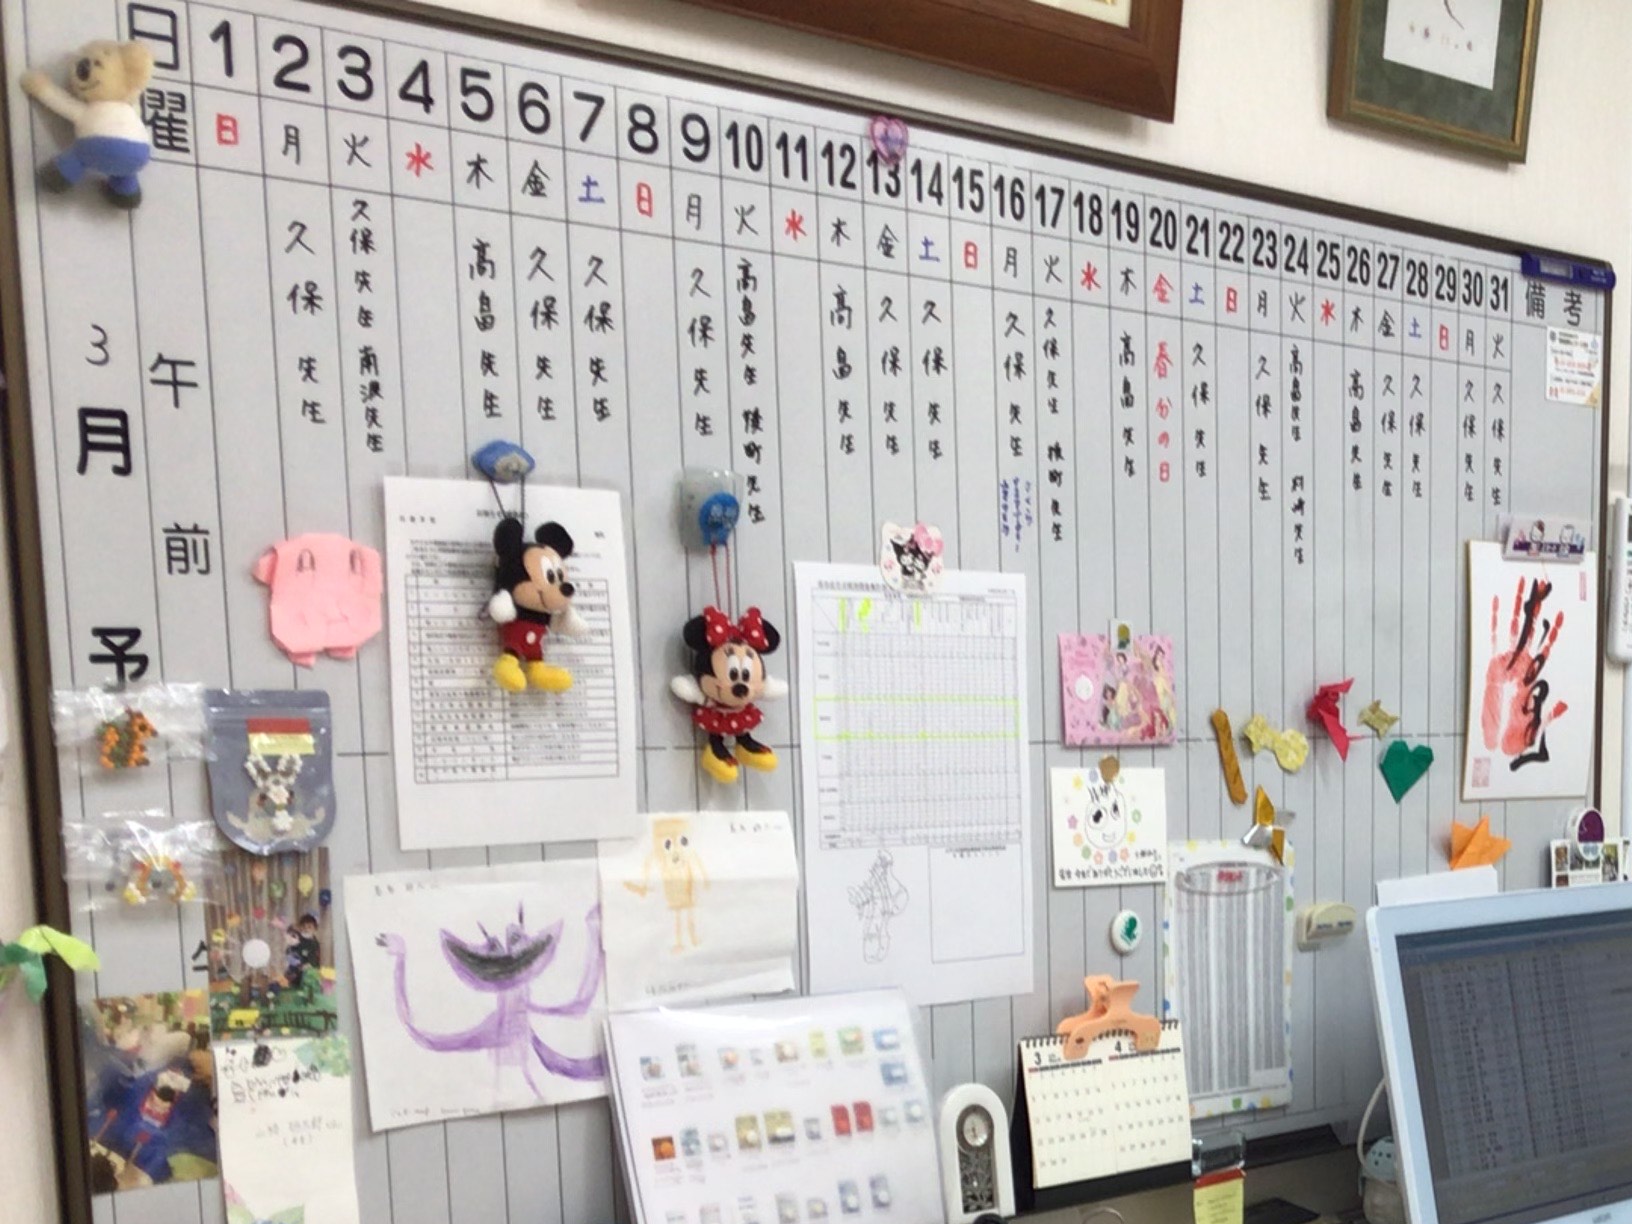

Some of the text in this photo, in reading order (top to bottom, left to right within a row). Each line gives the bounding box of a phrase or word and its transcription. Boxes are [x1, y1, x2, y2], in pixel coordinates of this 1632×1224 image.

[127, 2, 1582, 327] 日 1 2 3 4 5 6 7 8 9 10 11 12 13 14 15 16 17 18 19 20 21 22 23 24 25 26 27 28 29 30 31 備考
[140, 87, 191, 154] 曜
[216, 113, 1505, 359] 日 月 火 水 木 金 土 日 月 火 水 木 金 土 日 月 火 水 木 金 土 日 月 火 水 木 金 土 日 月 火
[350, 199, 377, 328] 久保先生
[86, 323, 110, 367] 3
[149, 352, 198, 409] 午
[284, 220, 326, 424] 久保先生
[527, 246, 560, 421] 久保先生
[583, 255, 615, 422] 久保先生
[687, 267, 715, 437] 久保先生
[878, 296, 903, 457] 久保先生
[921, 300, 948, 459] 久保先生
[1003, 311, 1026, 457] 久保先生
[77, 407, 132, 476] 月
[161, 521, 211, 576] 前
[89, 626, 149, 690] 予
[1034, 1041, 1122, 1066] 3 4
